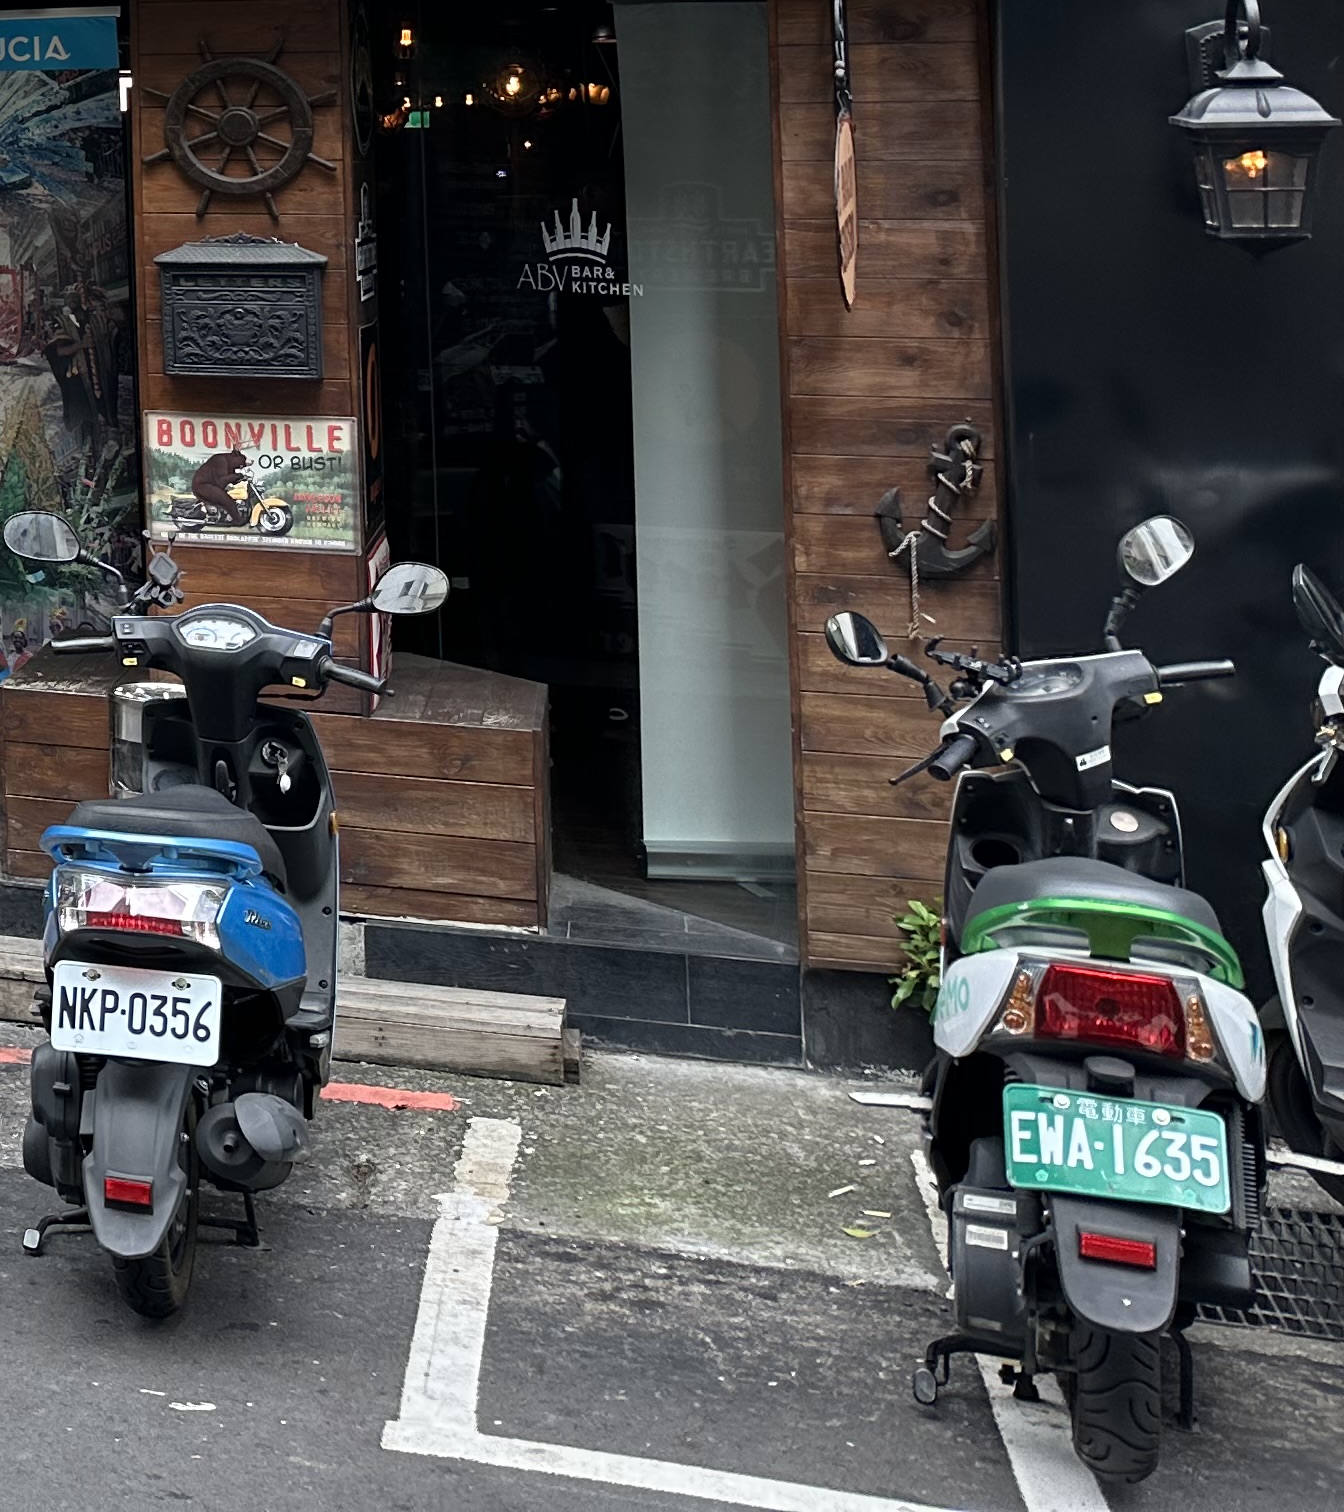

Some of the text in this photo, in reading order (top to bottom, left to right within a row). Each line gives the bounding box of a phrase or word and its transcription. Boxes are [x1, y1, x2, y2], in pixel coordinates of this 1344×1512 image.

[179, 277, 301, 287] LETTERS
[516, 263, 568, 292] ABV
[571, 281, 644, 297] KITCHEN
[156, 418, 344, 453] BOONVILLE
[258, 453, 342, 472] OR BUST!
[58, 986, 211, 1043] NKP-0356
[1077, 1099, 1147, 1126] 電動車
[1011, 1110, 1221, 1187] EWA-1635
